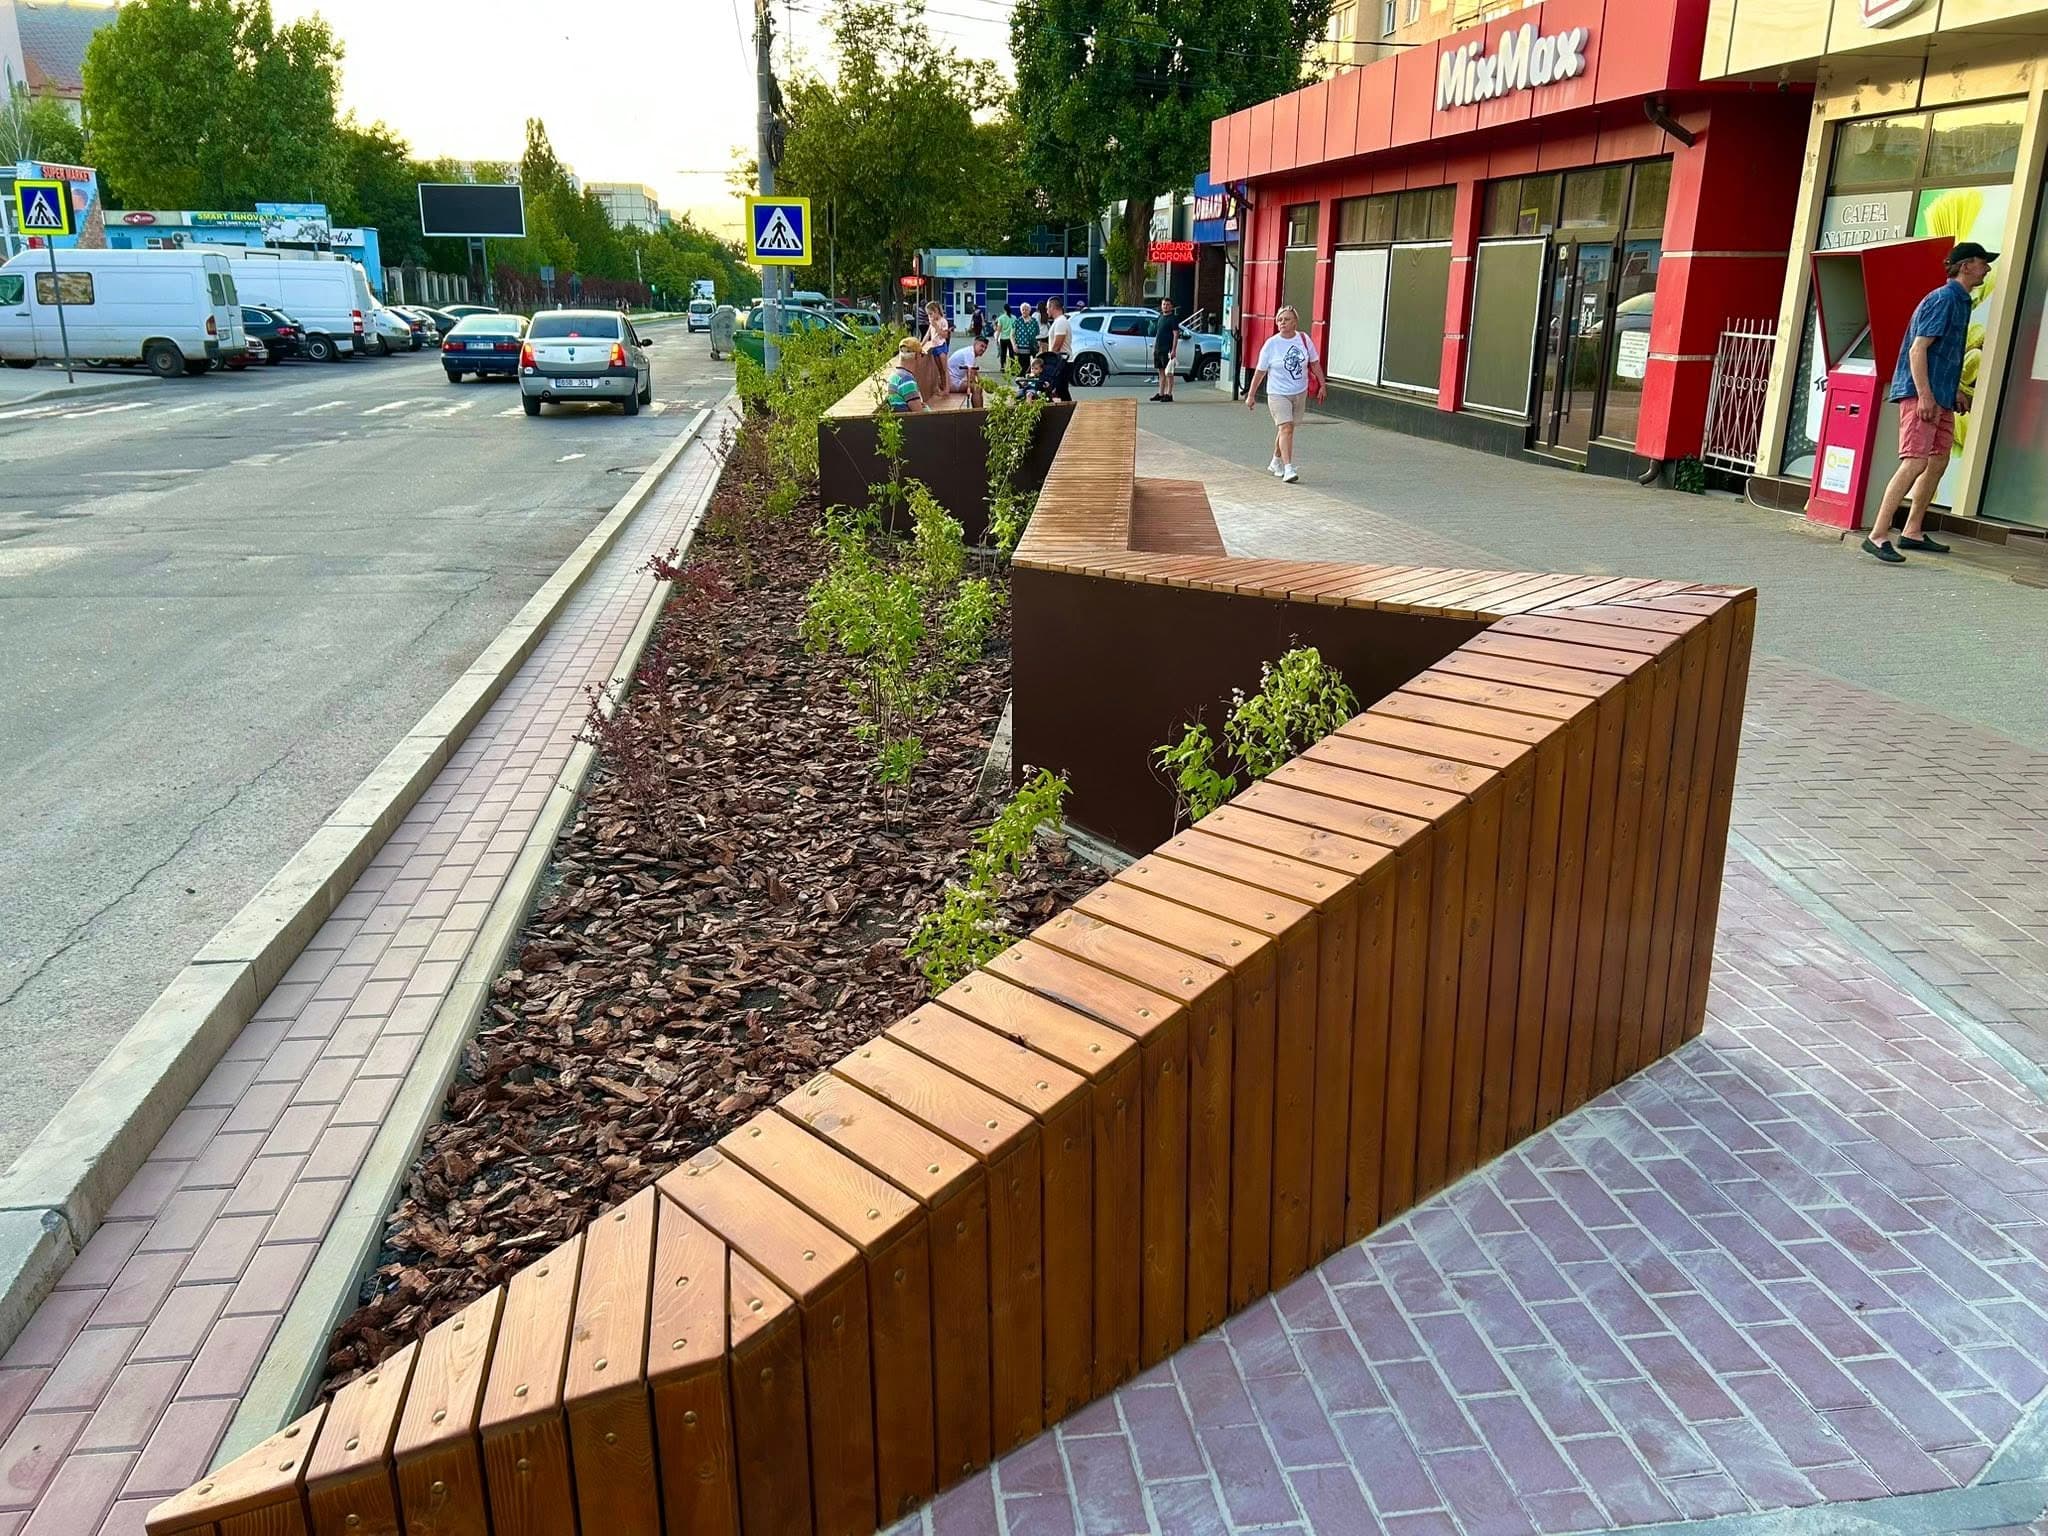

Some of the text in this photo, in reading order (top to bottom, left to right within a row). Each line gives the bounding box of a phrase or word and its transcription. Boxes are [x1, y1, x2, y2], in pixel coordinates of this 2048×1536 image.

[1437, 23, 1587, 112] MixMax
[42, 165, 66, 180] SUPER
[1192, 193, 1223, 220] LOMBARD
[1841, 202, 1888, 225] CAFEA
[1150, 241, 1194, 251] LOMBARD
[1152, 250, 1194, 261] CORONA
